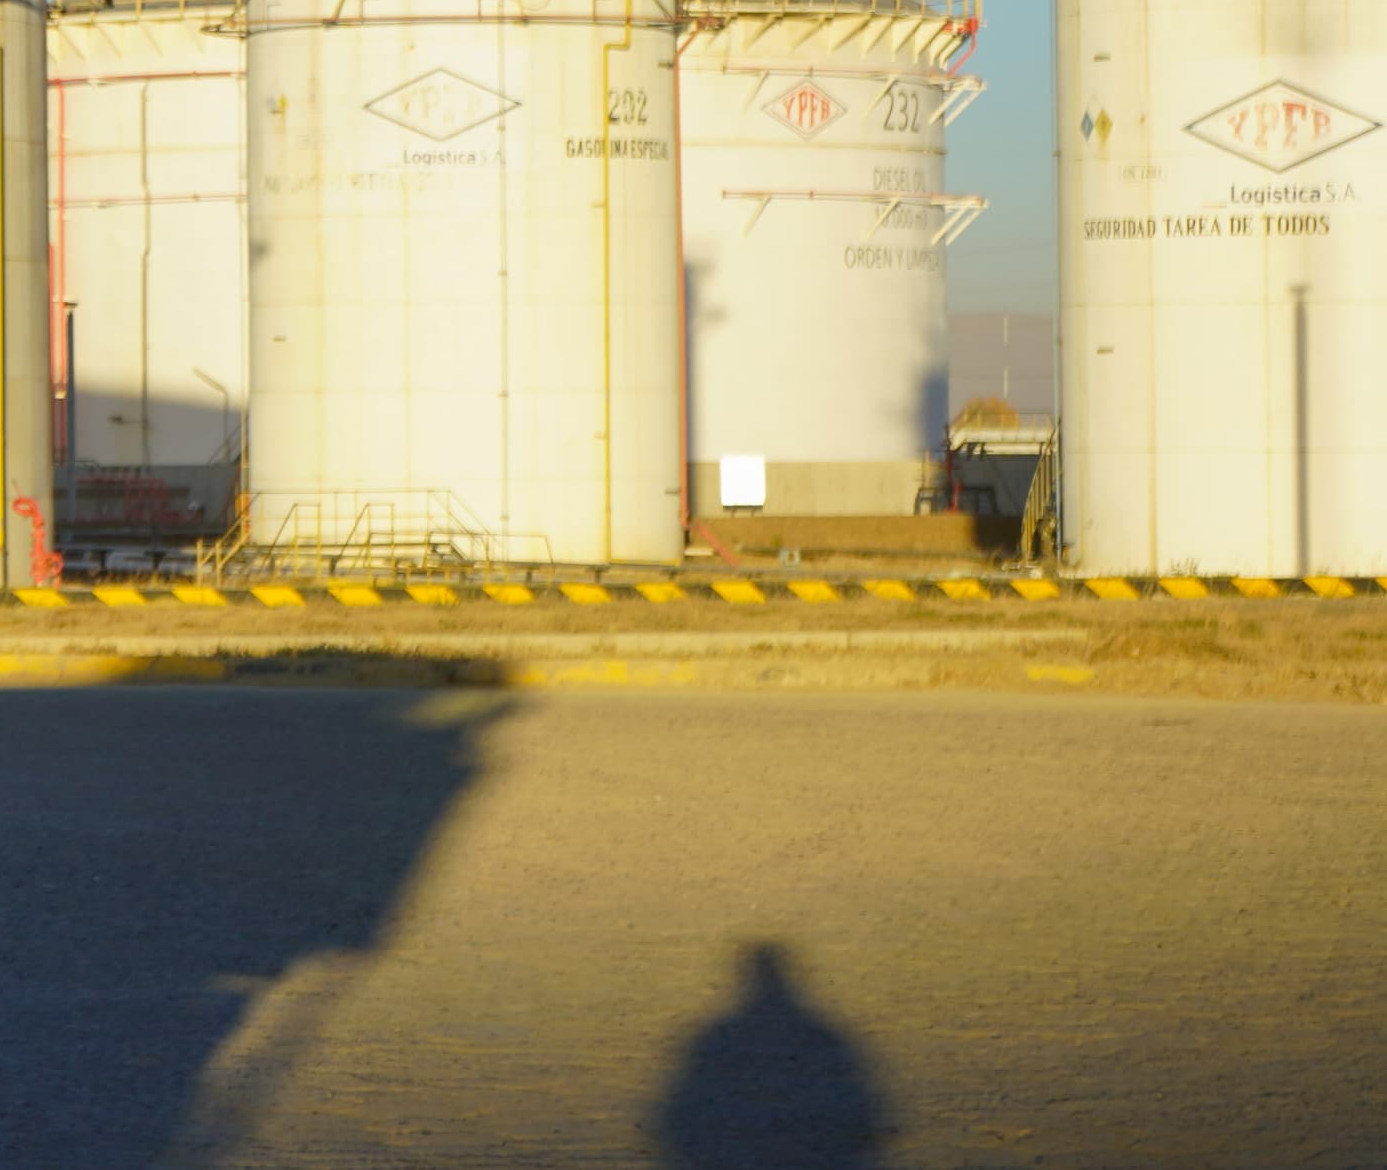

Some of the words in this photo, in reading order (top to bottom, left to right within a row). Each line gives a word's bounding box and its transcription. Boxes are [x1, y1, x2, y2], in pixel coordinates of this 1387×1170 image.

[783, 90, 831, 128] YPFB
[883, 89, 920, 133] 232
[1228, 101, 1332, 153] YPFB
[566, 138, 628, 159] GASOINA
[873, 169, 912, 191] DIESEL
[1084, 216, 1156, 240] SEGURIDAD
[1163, 214, 1222, 238] TAREA
[1229, 214, 1253, 237] DE
[1263, 213, 1331, 237] TODOS
[844, 245, 891, 270] ORDEN
[894, 246, 904, 268] Y
